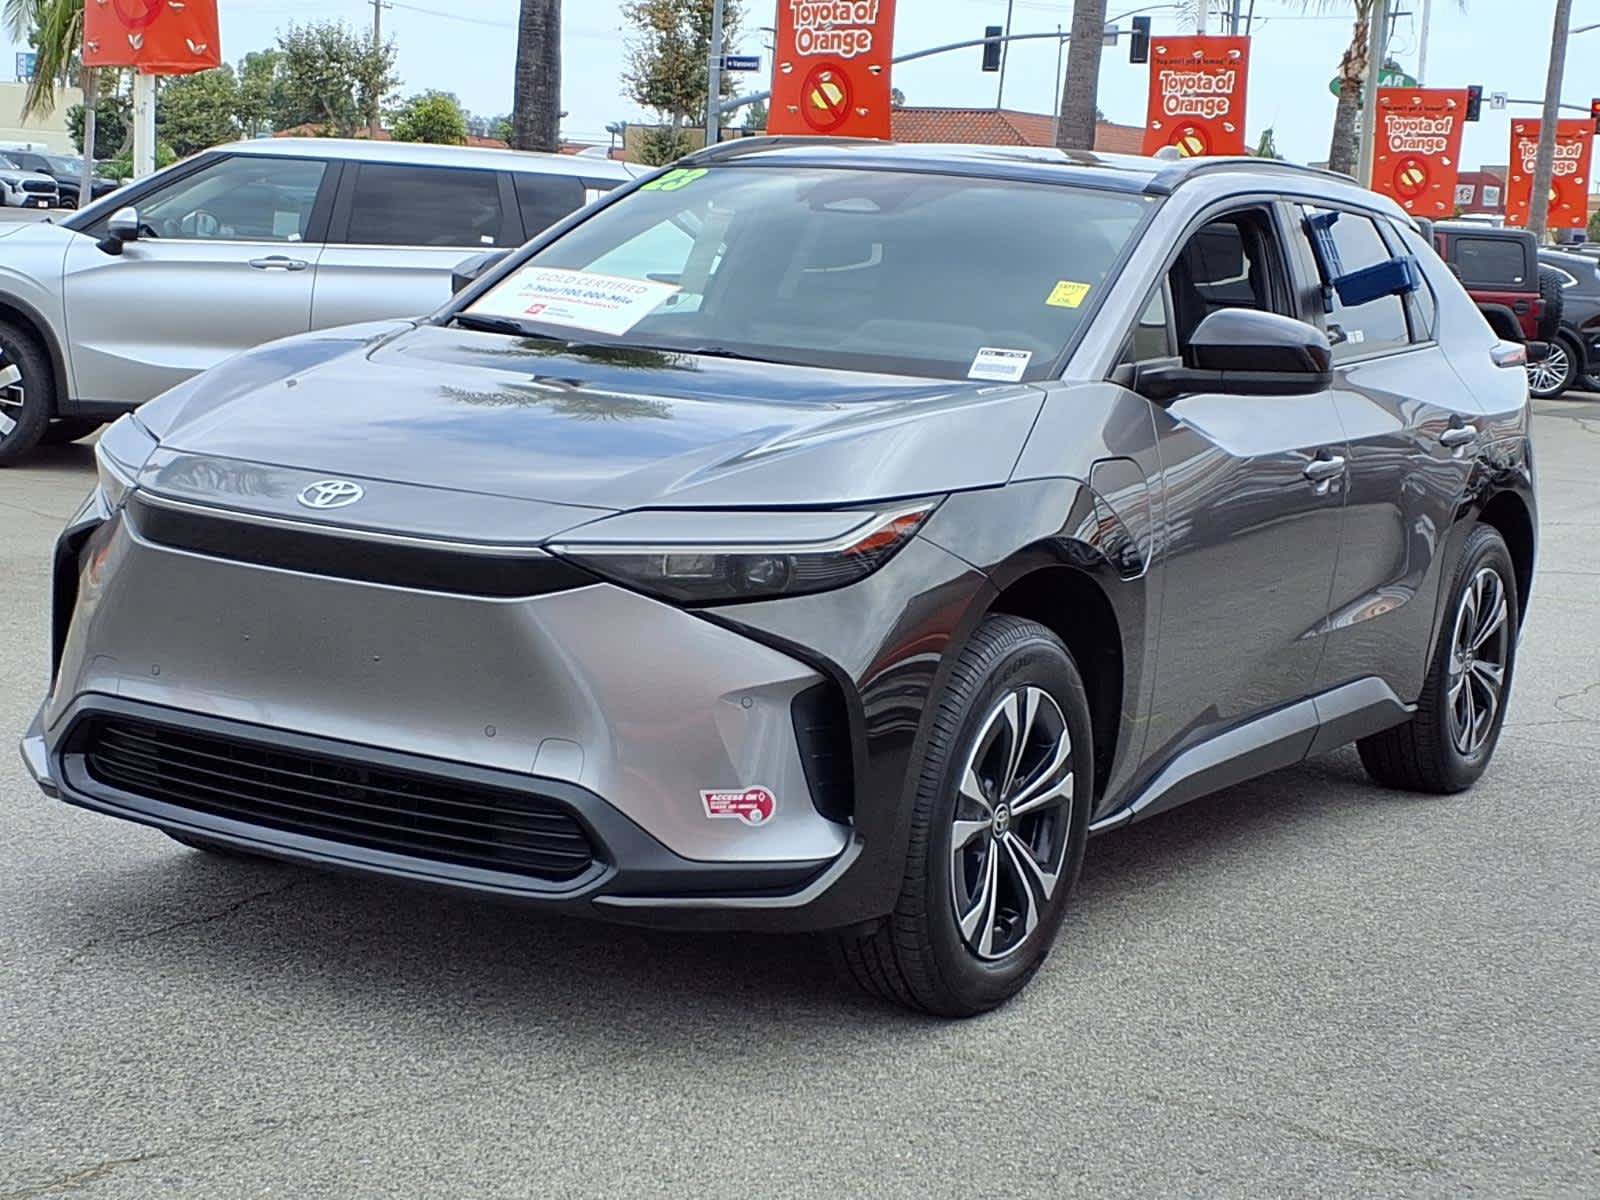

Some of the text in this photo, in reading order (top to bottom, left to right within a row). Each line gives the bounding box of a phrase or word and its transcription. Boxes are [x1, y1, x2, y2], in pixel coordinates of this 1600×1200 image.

[790, 0, 879, 28] Toyota of
[796, 25, 872, 57] Orange
[1160, 70, 1235, 95] Toyota of
[1163, 94, 1229, 119] Orange
[1385, 115, 1453, 136] Toyota of
[1389, 134, 1448, 154] Orange
[1566, 143, 1583, 159] of
[641, 168, 709, 191] 23
[535, 272, 648, 294] GOLD CERTIFIED
